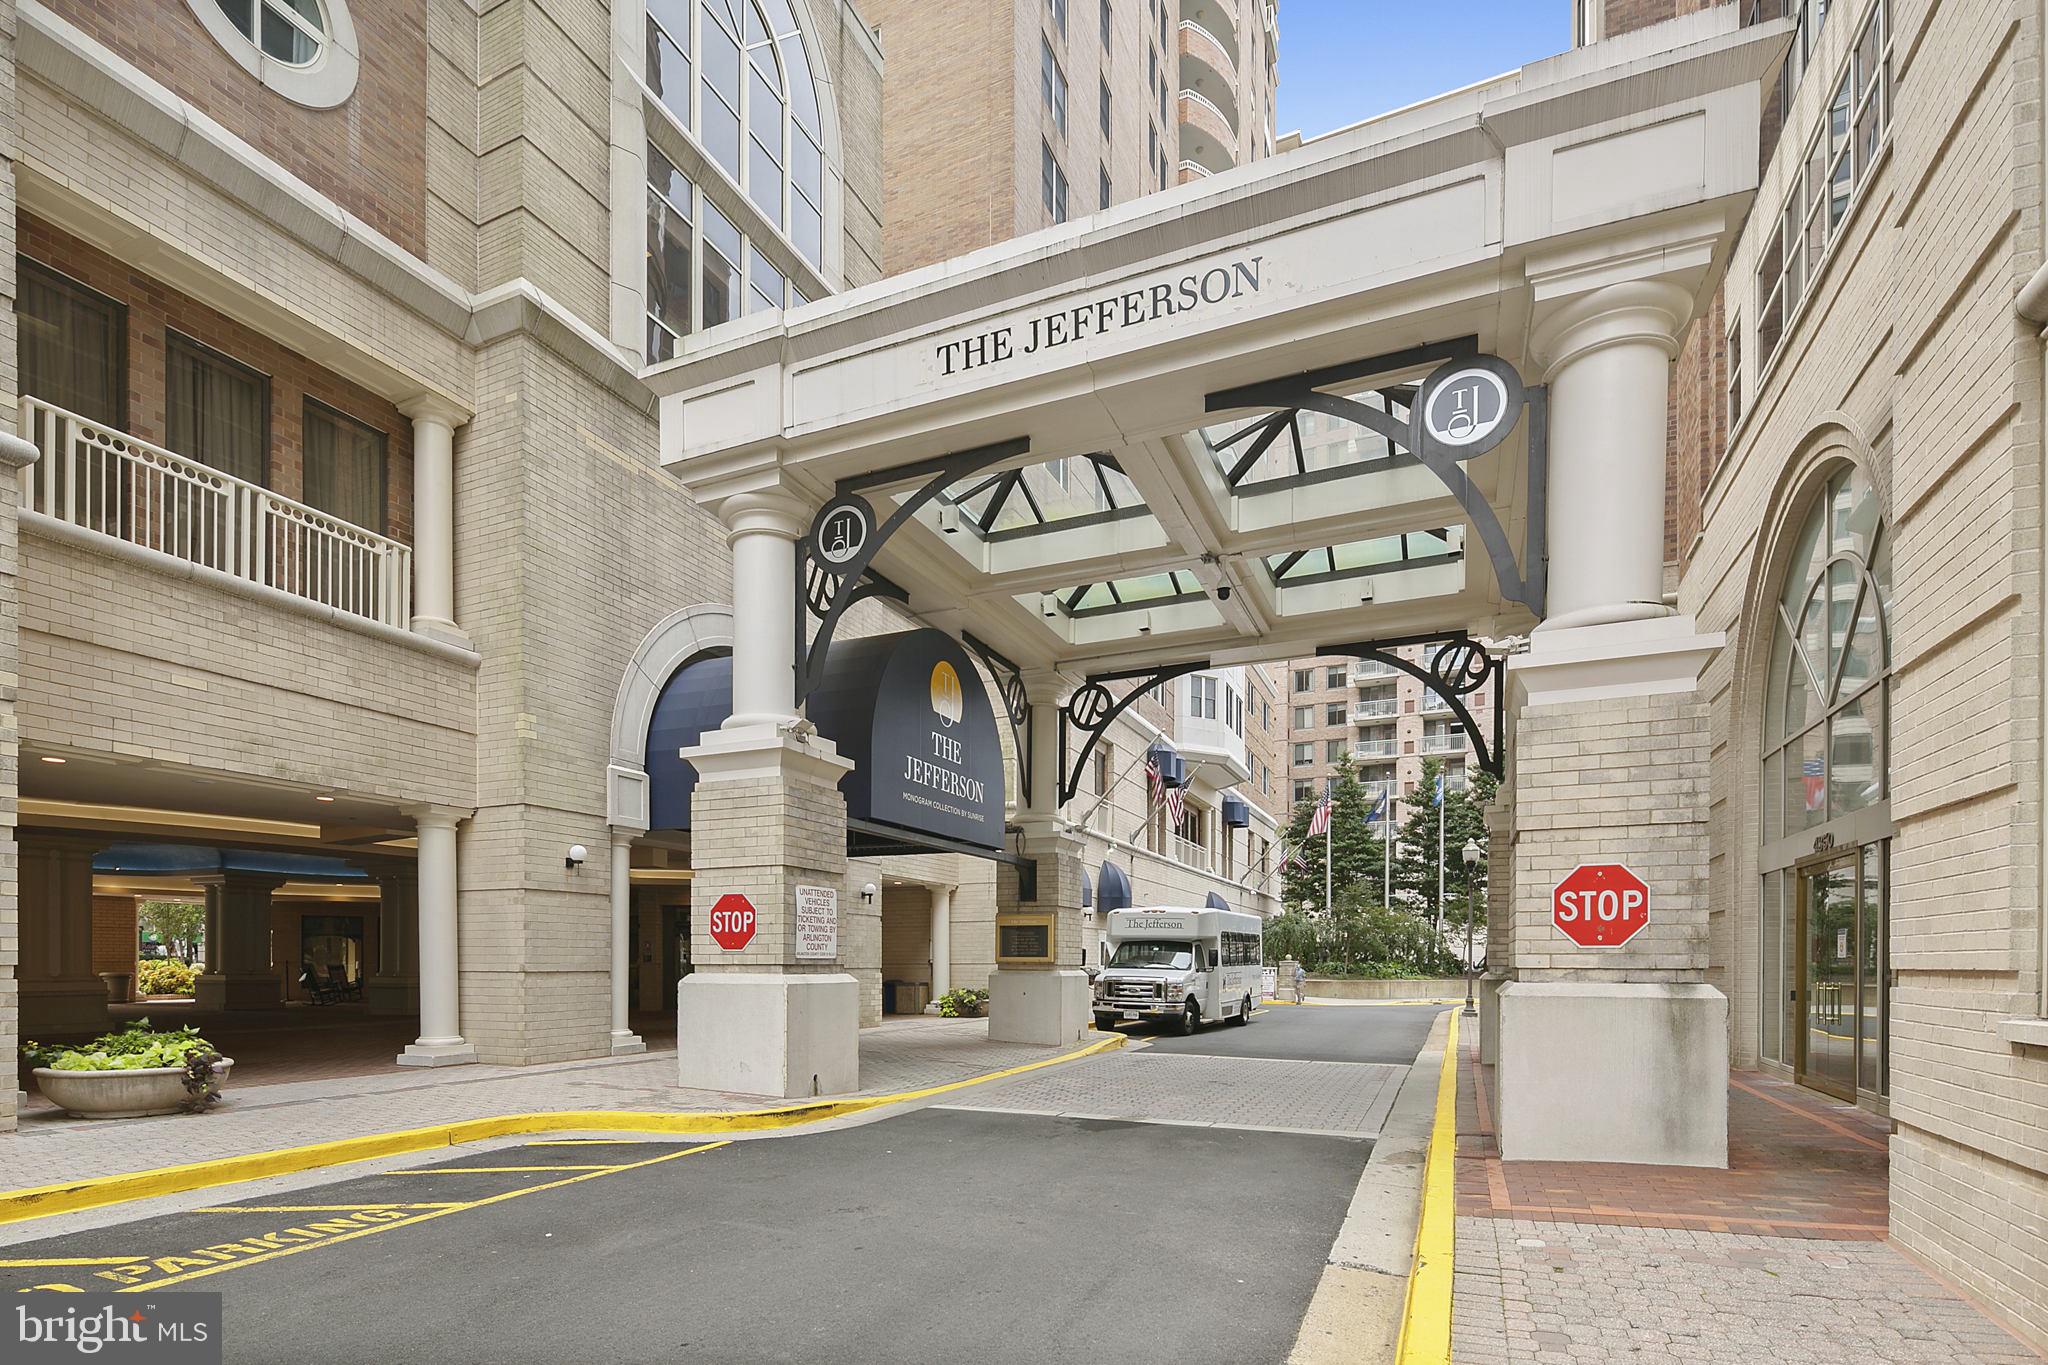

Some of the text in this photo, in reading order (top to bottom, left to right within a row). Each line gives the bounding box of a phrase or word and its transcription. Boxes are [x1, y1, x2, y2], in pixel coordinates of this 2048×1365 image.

[936, 256, 1264, 377] THE JEFFERSON
[931, 731, 962, 765] THE
[904, 755, 984, 804] JEFFERSON
[902, 792, 984, 822] MONOGRAM COLLECTION BY SUNRISE
[799, 888, 834, 898] UNATTENDED
[804, 897, 830, 906] VEHICLES
[801, 906, 825, 915] SUBJECT
[1558, 889, 1643, 922] STOP
[712, 910, 754, 933] STOP
[797, 915, 837, 925] TICKETING AND
[797, 924, 836, 933] OR TOWING BY
[1126, 918, 1183, 931] The Jefferson
[802, 933, 832, 942] ARLINGTON
[93, 1209, 410, 1284] PARKING
